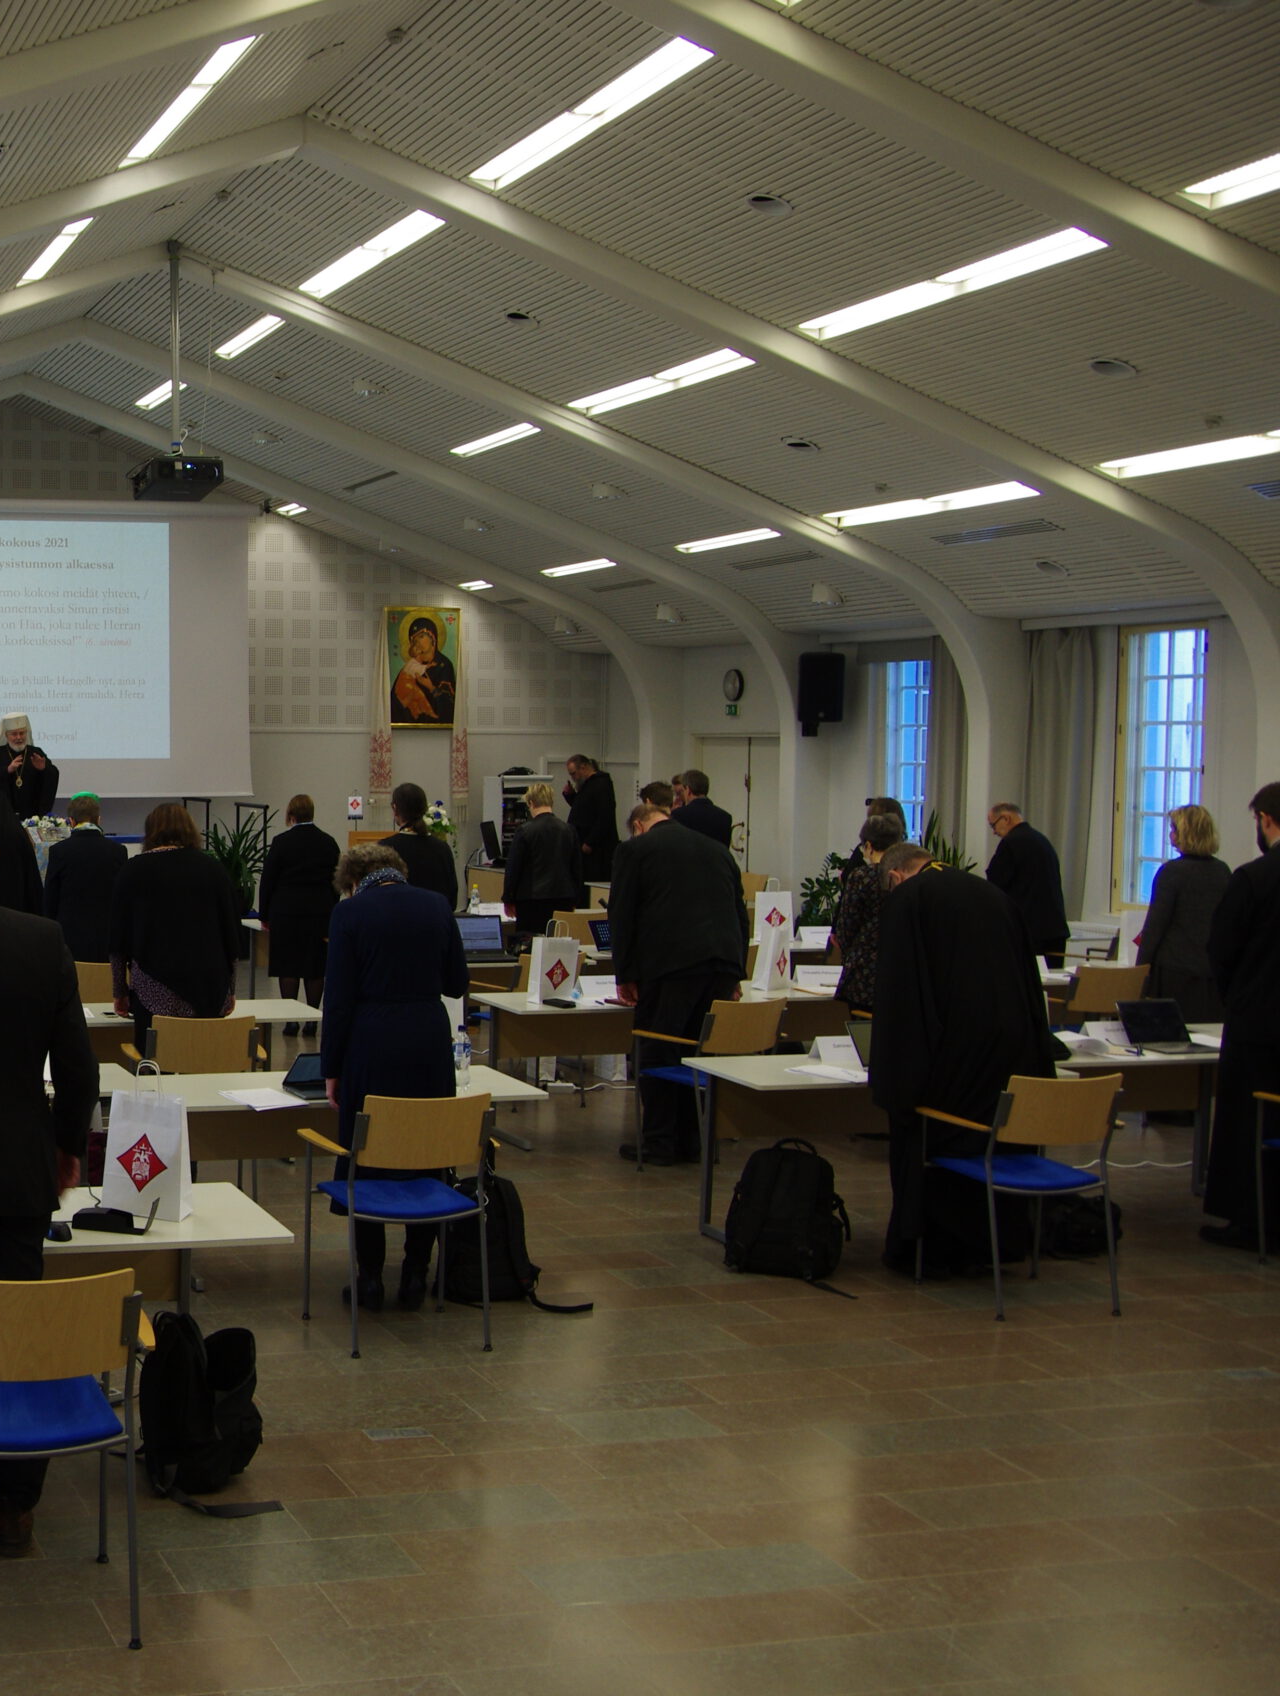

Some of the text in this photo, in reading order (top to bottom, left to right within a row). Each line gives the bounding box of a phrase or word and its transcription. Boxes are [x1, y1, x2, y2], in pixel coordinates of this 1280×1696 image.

[44, 537, 69, 548] 2021
[66, 559, 114, 569] alkaessa
[24, 587, 60, 598] kokosi
[102, 587, 140, 601] yhteen,
[67, 603, 98, 614] Sinun
[102, 603, 129, 614] ristisi
[1, 622, 15, 630] on
[48, 619, 71, 632] joka
[74, 619, 100, 630] tulee
[104, 619, 141, 631] Herran
